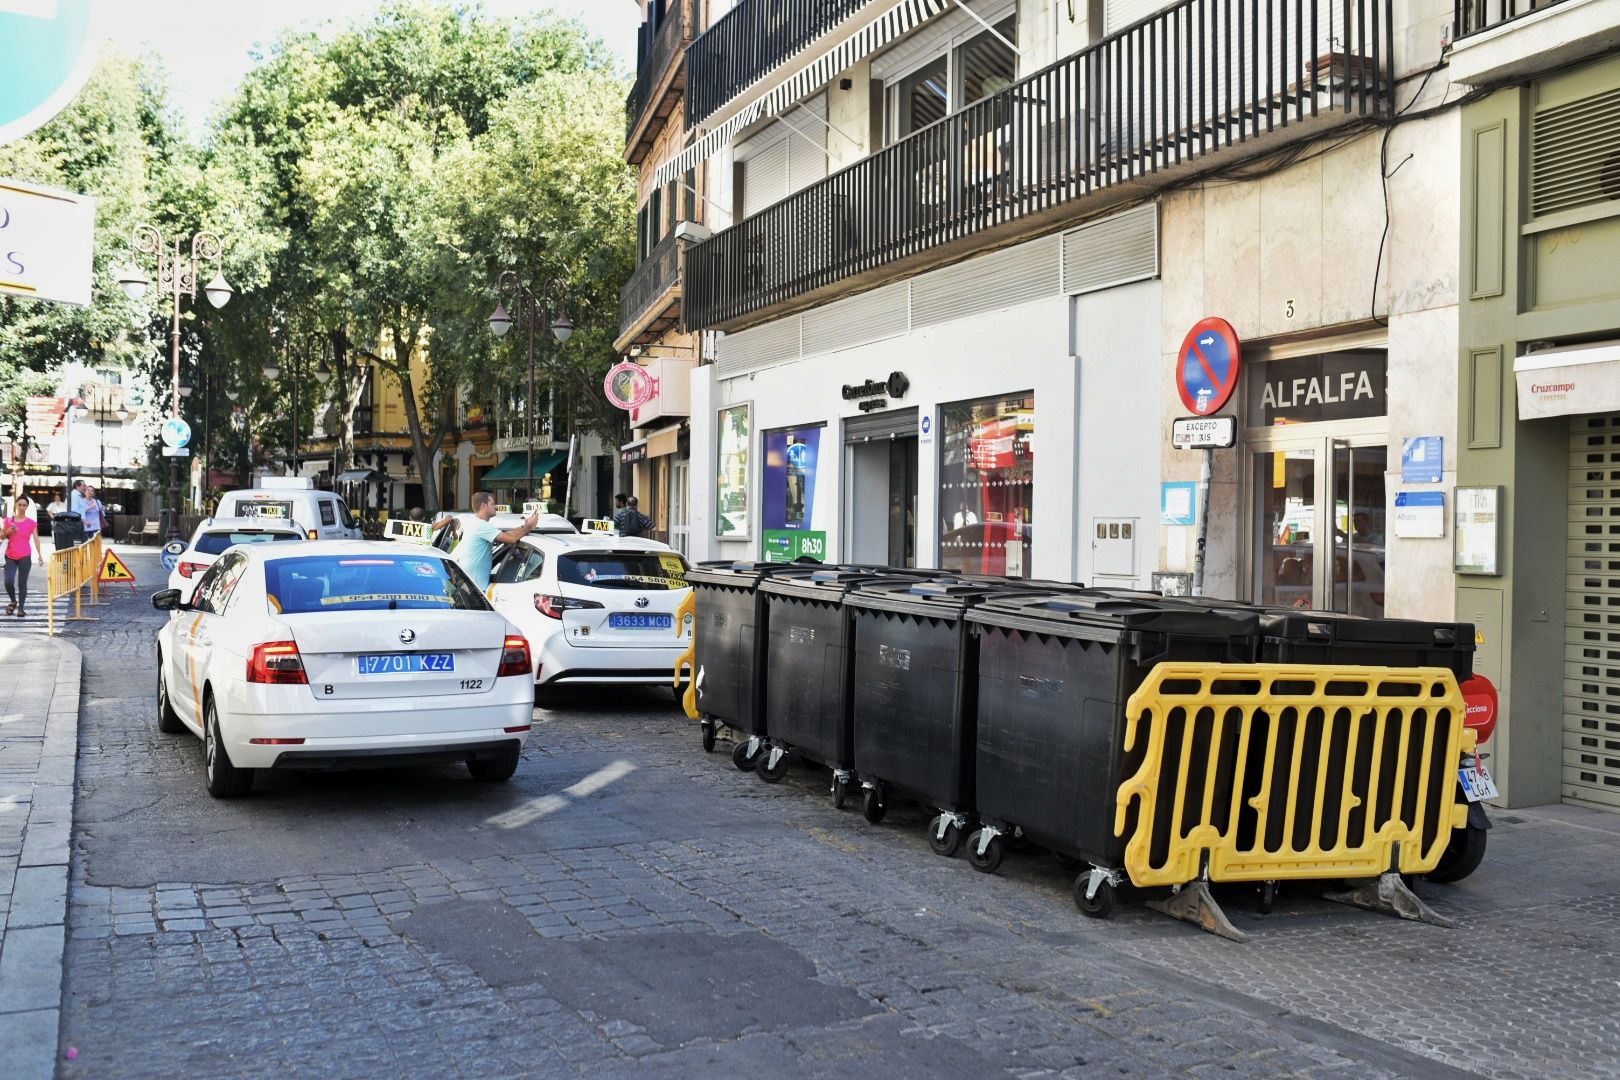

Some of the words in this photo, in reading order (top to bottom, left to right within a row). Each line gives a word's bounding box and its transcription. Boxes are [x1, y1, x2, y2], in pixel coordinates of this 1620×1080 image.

[1286, 300, 1295, 318] 3
[1259, 370, 1375, 409] ALFALFA
[1531, 382, 1576, 394] Cruzcampo
[1186, 421, 1218, 431] EXCEPTO
[401, 523, 424, 538] TAXI
[593, 521, 609, 531] TAXI
[801, 537, 822, 554] 8h30
[616, 615, 645, 628] 3633
[369, 655, 412, 672] 7701
[418, 654, 452, 670] KZZ
[324, 684, 334, 694] B
[459, 680, 483, 690] 1122
[1466, 704, 1488, 714] acciona
[1466, 768, 1490, 783] 478
